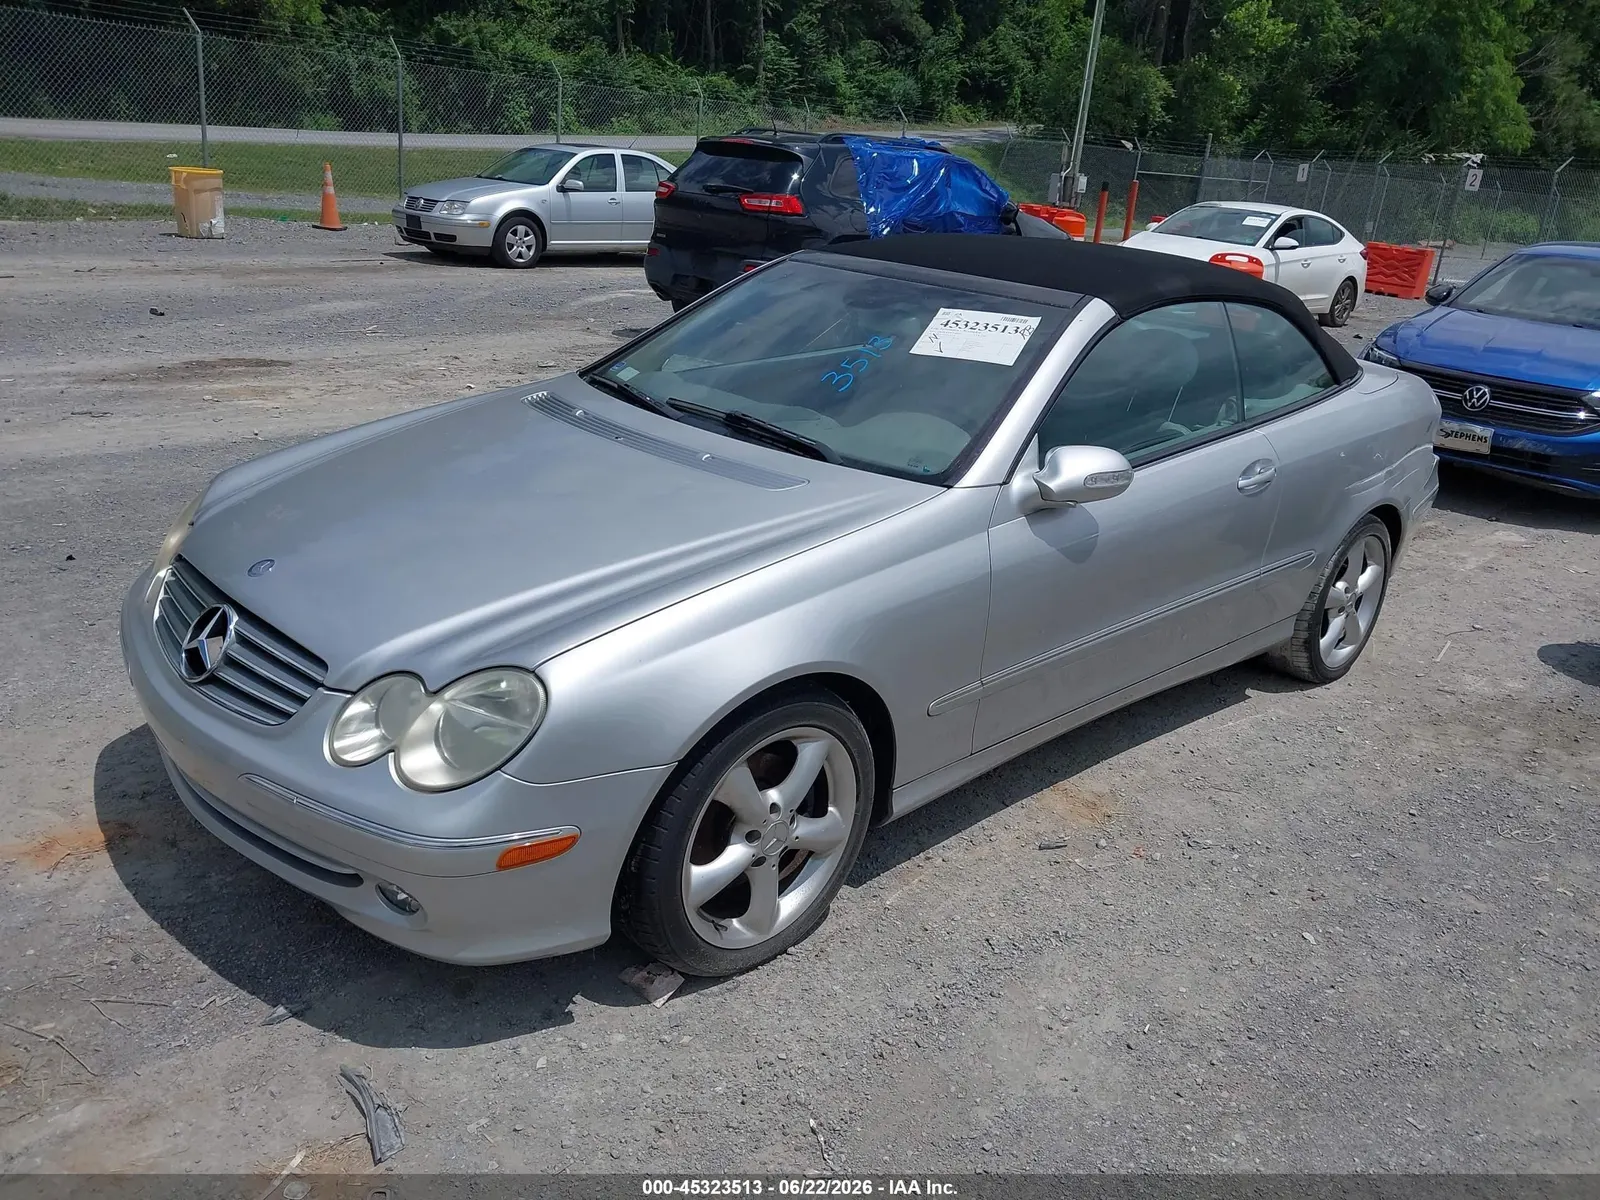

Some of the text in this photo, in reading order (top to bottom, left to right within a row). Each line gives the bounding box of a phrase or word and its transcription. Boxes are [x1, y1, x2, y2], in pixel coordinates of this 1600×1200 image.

[1468, 173, 1479, 187] 2
[940, 319, 1020, 335] 45323513
[1440, 428, 1488, 443] STEPHENS
